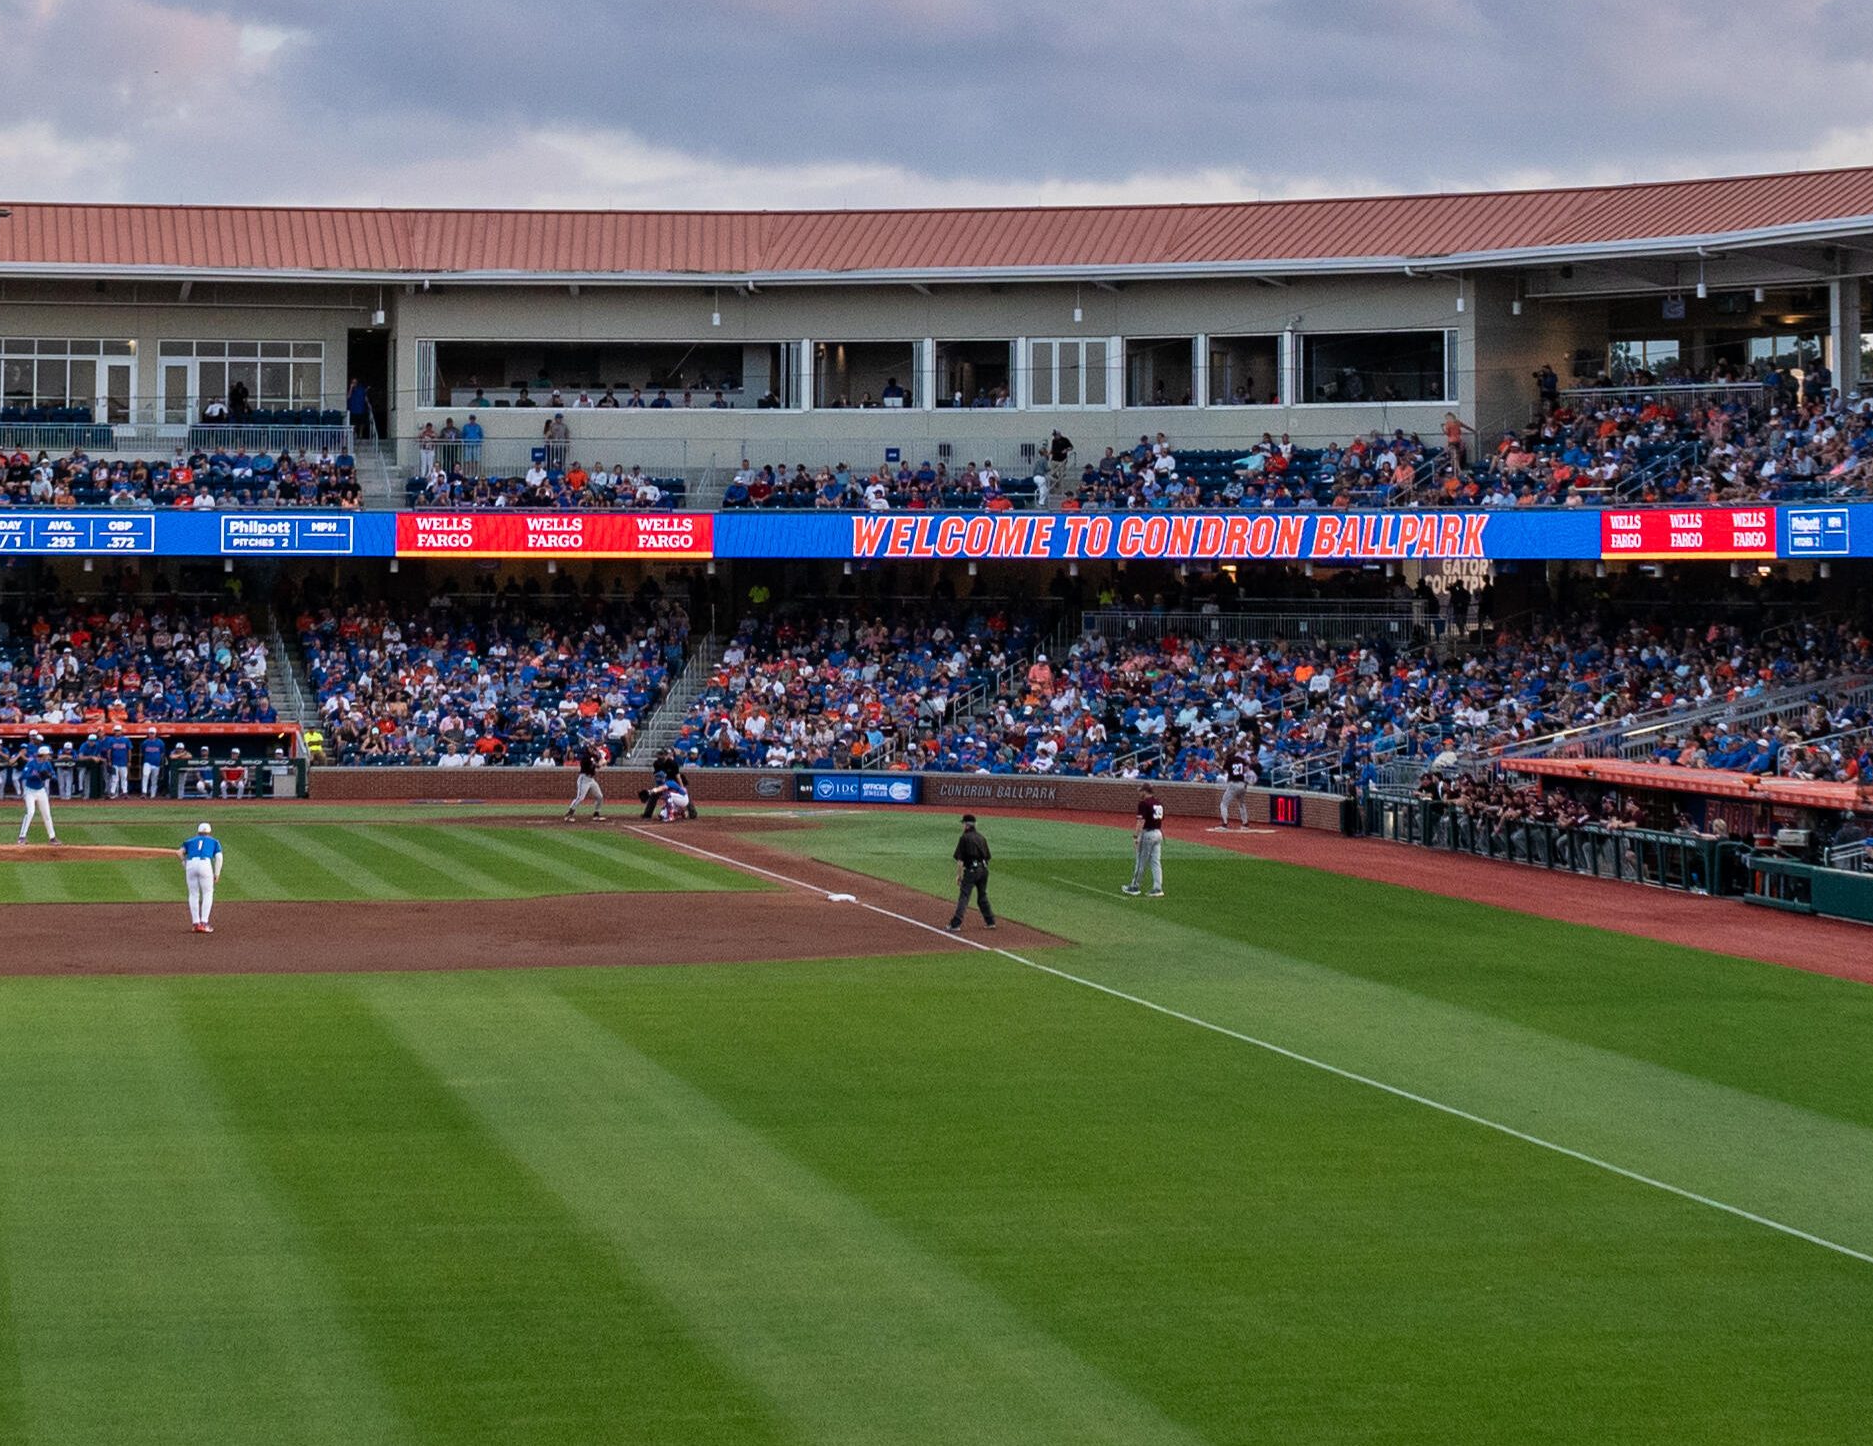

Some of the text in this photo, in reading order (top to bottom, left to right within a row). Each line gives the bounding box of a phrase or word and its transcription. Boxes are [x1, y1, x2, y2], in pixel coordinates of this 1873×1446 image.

[47, 521, 75, 531] AVG.
[108, 521, 133, 531] OBP
[416, 518, 472, 531] WELLS
[527, 518, 582, 532] WELLS
[637, 518, 693, 532] WELLS
[1610, 514, 1641, 529] WELLS
[1670, 513, 1702, 528] WELLS
[1732, 512, 1766, 528] WELLS
[229, 520, 291, 535] Philpott
[311, 522, 337, 533] MPH
[47, 536, 76, 548] .293
[106, 537, 135, 548] .372
[417, 533, 472, 547] FARGO
[527, 534, 583, 548] FARGO
[637, 534, 693, 548] FARGO
[851, 513, 1489, 558] WELCOME TO CONDRON BALLPARK
[1611, 533, 1642, 548] FARGO
[1670, 532, 1702, 547] FARGO
[1733, 531, 1766, 546] FARGO
[233, 538, 289, 548] PITCHES 2
[1442, 559, 1488, 575] GATOR
[940, 784, 1057, 800] CONDRON BALLPARK
